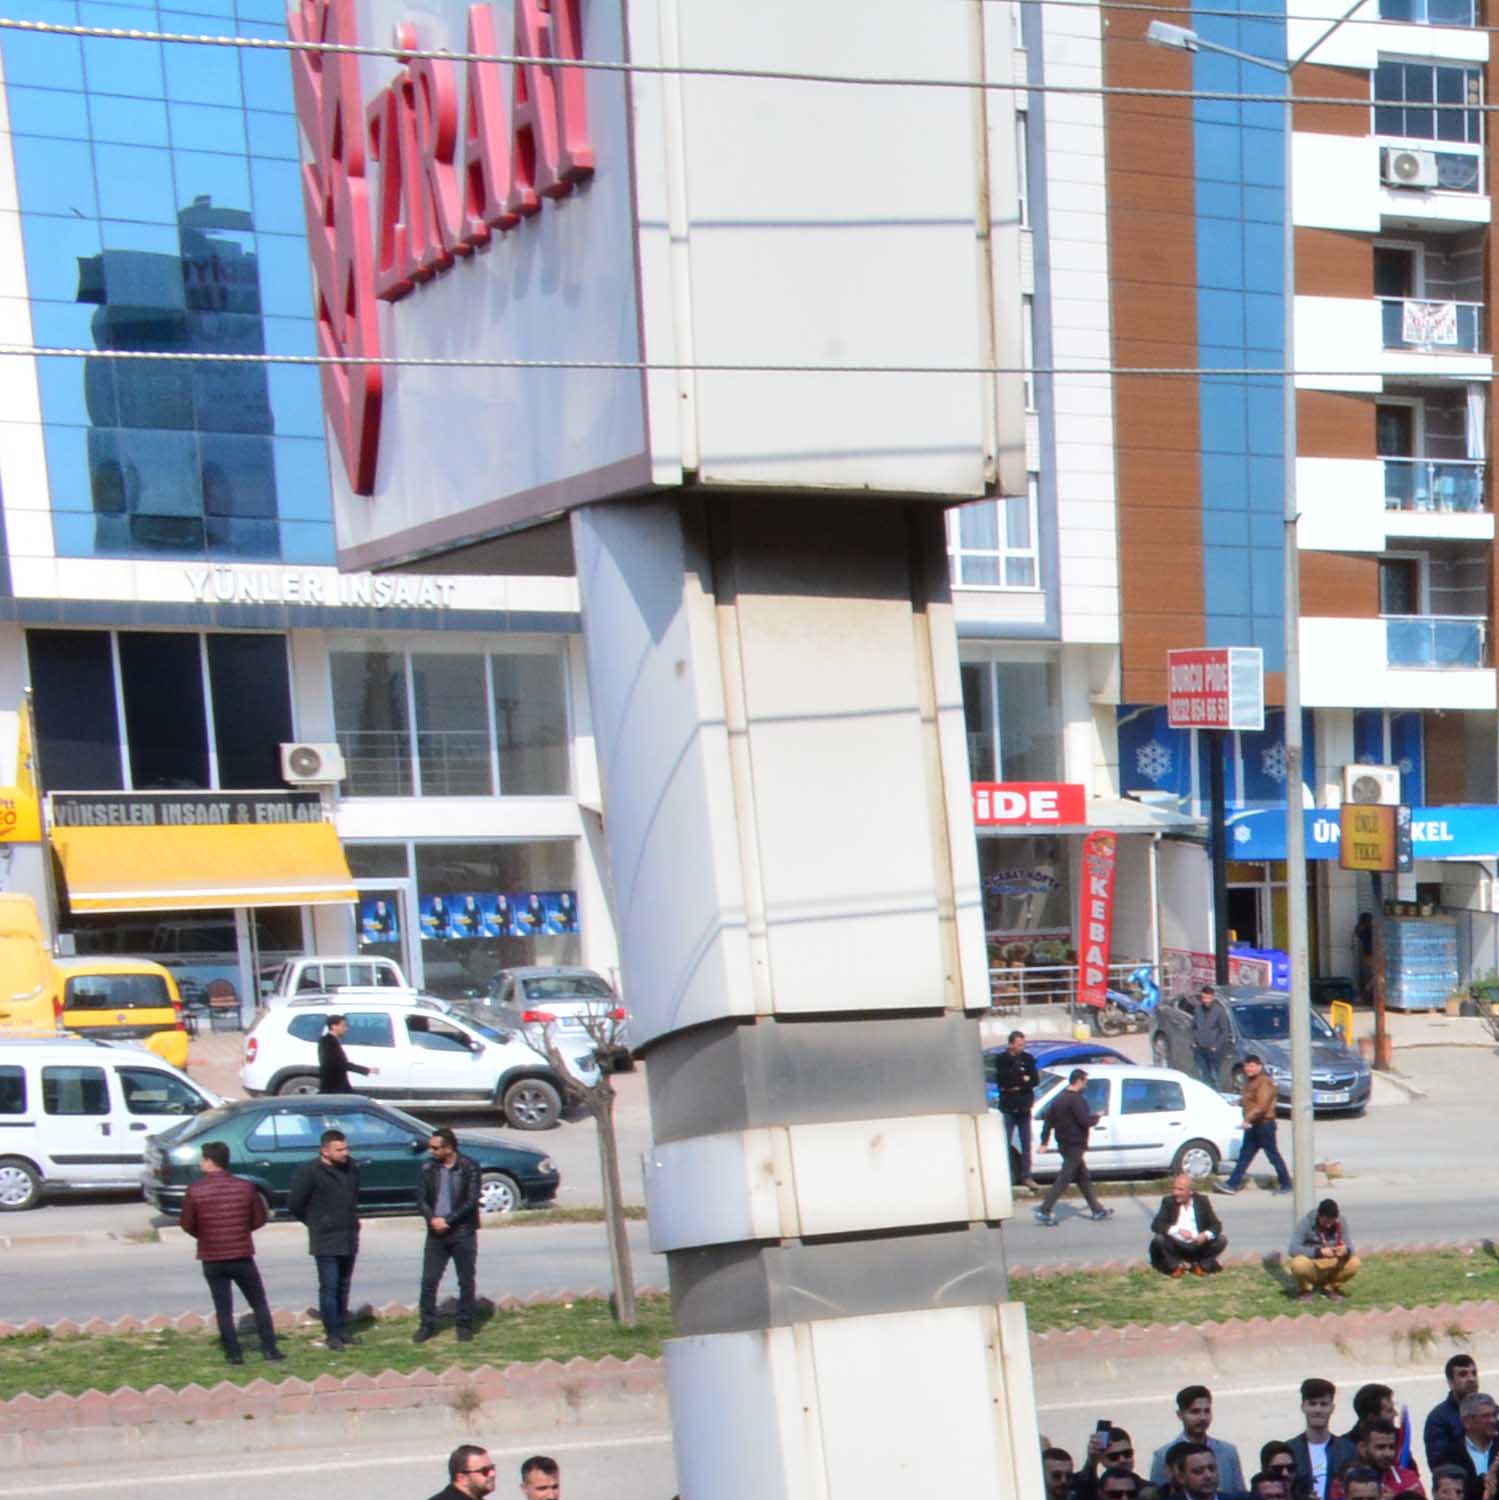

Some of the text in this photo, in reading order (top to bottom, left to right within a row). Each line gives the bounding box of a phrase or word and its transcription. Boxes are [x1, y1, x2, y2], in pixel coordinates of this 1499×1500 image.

[184, 567, 325, 605] YÜNLER
[976, 789, 1060, 820] İDE
[1084, 877, 1109, 988] KEBAP
